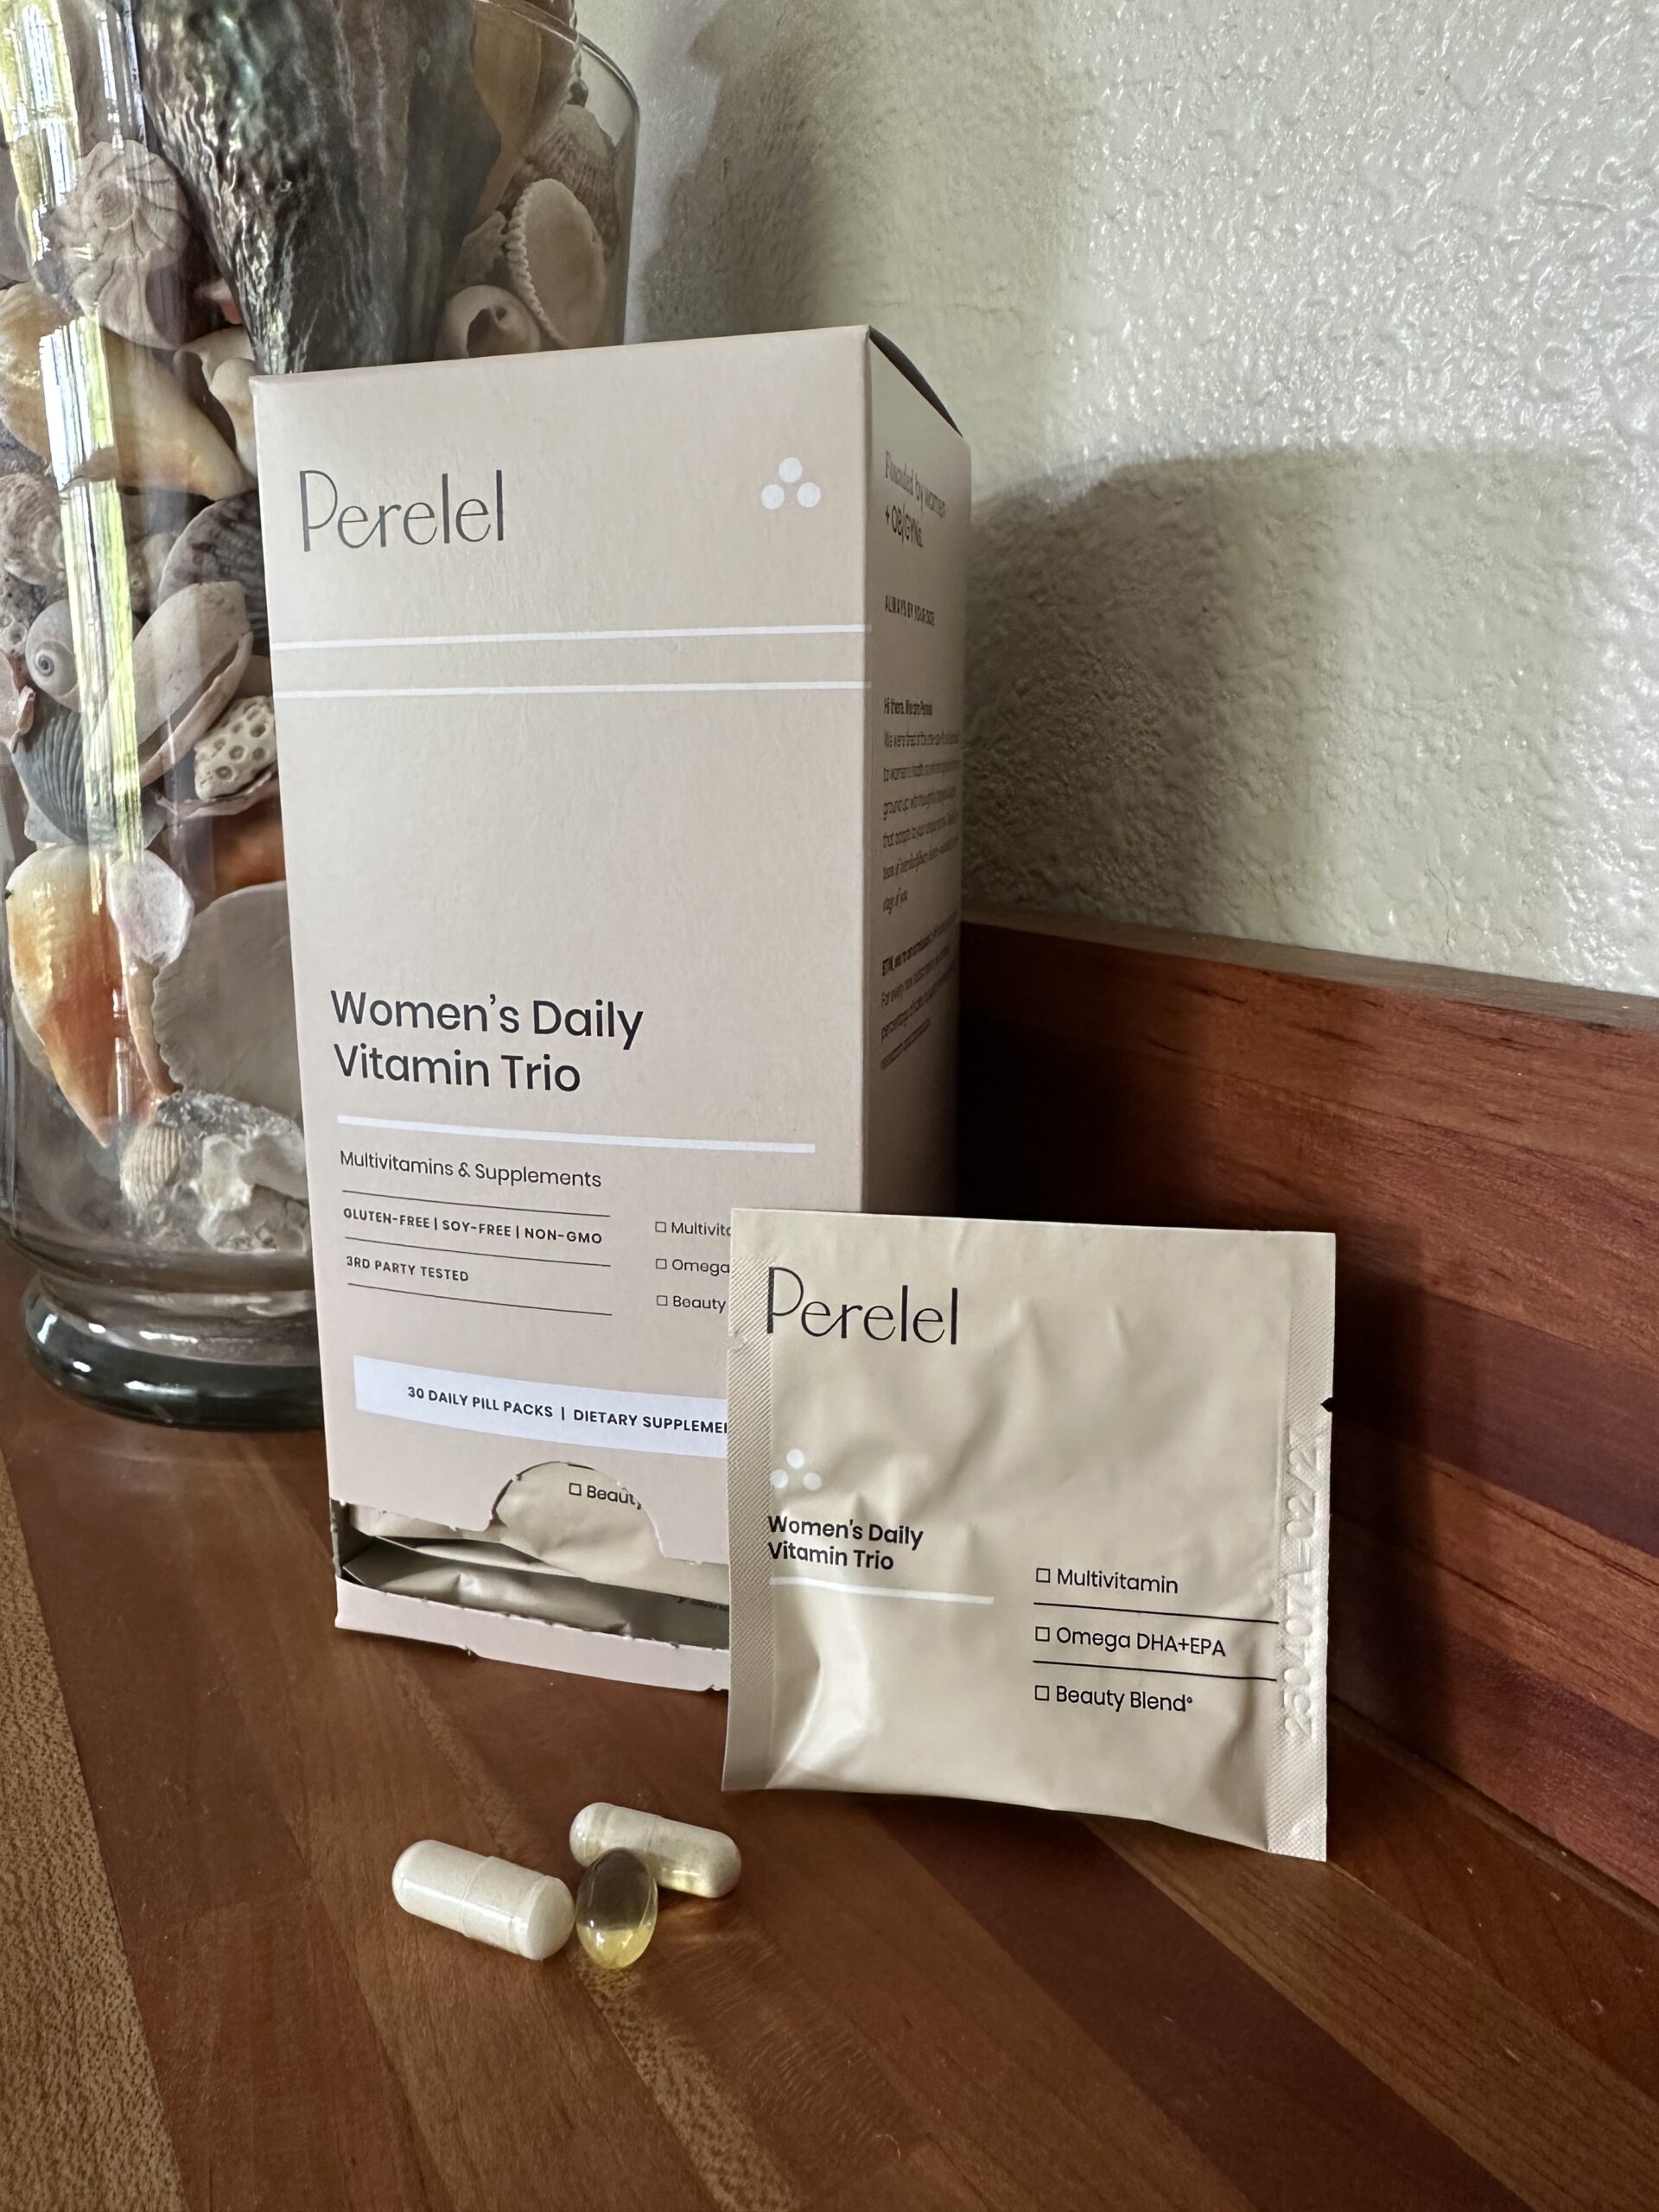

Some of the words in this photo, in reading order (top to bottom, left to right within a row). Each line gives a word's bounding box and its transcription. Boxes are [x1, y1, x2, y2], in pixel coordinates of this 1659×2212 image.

[299, 469, 504, 552] Perelel
[330, 989, 520, 1034] Women’s
[533, 999, 644, 1051] Daily
[334, 1042, 490, 1088] Vitamin
[500, 1053, 581, 1092] Trio
[340, 1150, 454, 1176] Multivitamins
[457, 1161, 471, 1178] &
[474, 1163, 601, 1187] Supplements
[343, 1207, 430, 1229] GLUTEN-FREE
[442, 1219, 512, 1237] SOY-FREE
[524, 1227, 602, 1244] NON-GMO
[346, 1255, 371, 1269] 3RD
[374, 1260, 416, 1275] PARTY
[419, 1266, 469, 1282] TESTED
[671, 1258, 731, 1277] Omega
[672, 1295, 727, 1314] Beauty
[766, 1266, 958, 1345] Perelel
[407, 1386, 424, 1400] 30
[428, 1389, 468, 1407] DAILY
[472, 1396, 500, 1411] PILL
[503, 1401, 553, 1418] PACKS
[573, 1408, 638, 1427] DIETARY
[766, 1516, 863, 1541] Women's
[868, 1523, 925, 1552] Daily
[766, 1540, 848, 1567] Vitamin
[853, 1549, 894, 1571] Trio
[1057, 1567, 1179, 1594] Multivitamin
[1056, 1626, 1131, 1653] Omega
[1136, 1632, 1226, 1657] DHA+EPA
[1056, 1685, 1126, 1713] Beauty
